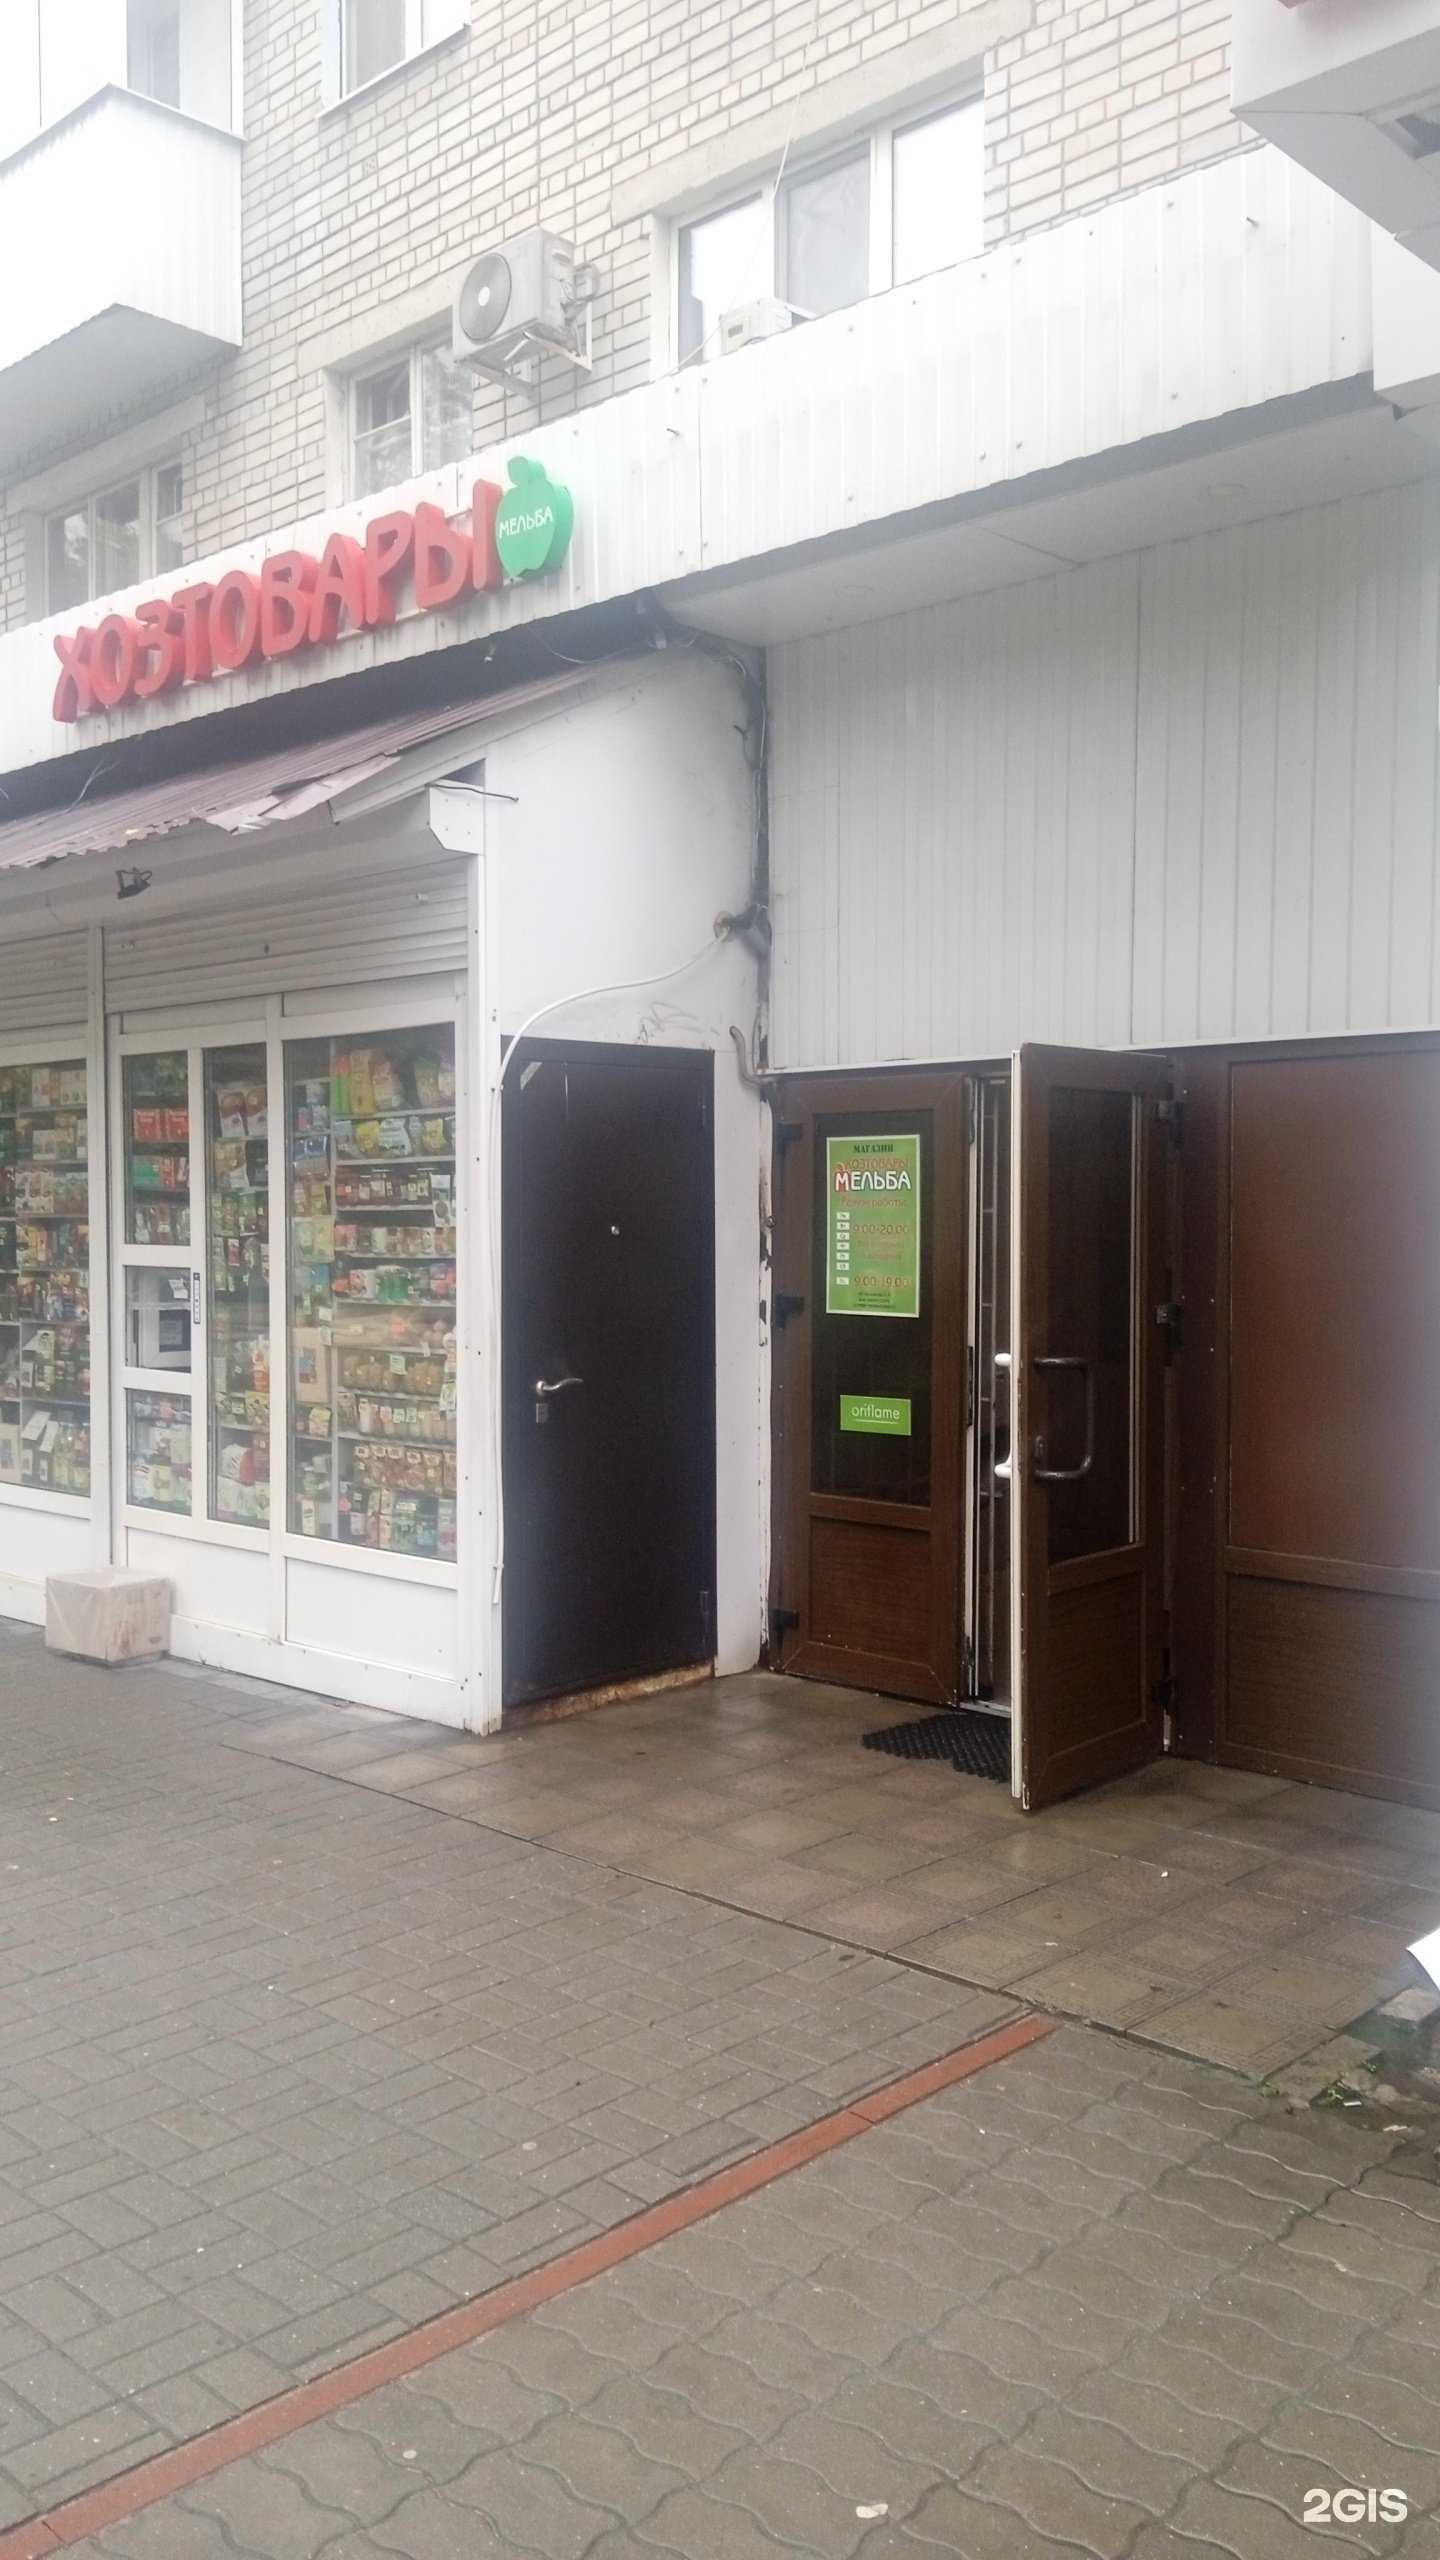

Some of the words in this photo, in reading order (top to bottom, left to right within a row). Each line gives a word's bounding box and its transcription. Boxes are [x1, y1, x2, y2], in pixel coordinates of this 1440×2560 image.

[499, 505, 554, 539] МЕЛЬБА
[53, 480, 501, 723] ХОЗТОВАРЫ
[853, 1144, 894, 1153] МАГАЗИН
[834, 1170, 912, 1192] МЕЛЬБА
[851, 1403, 900, 1420] oriflame
